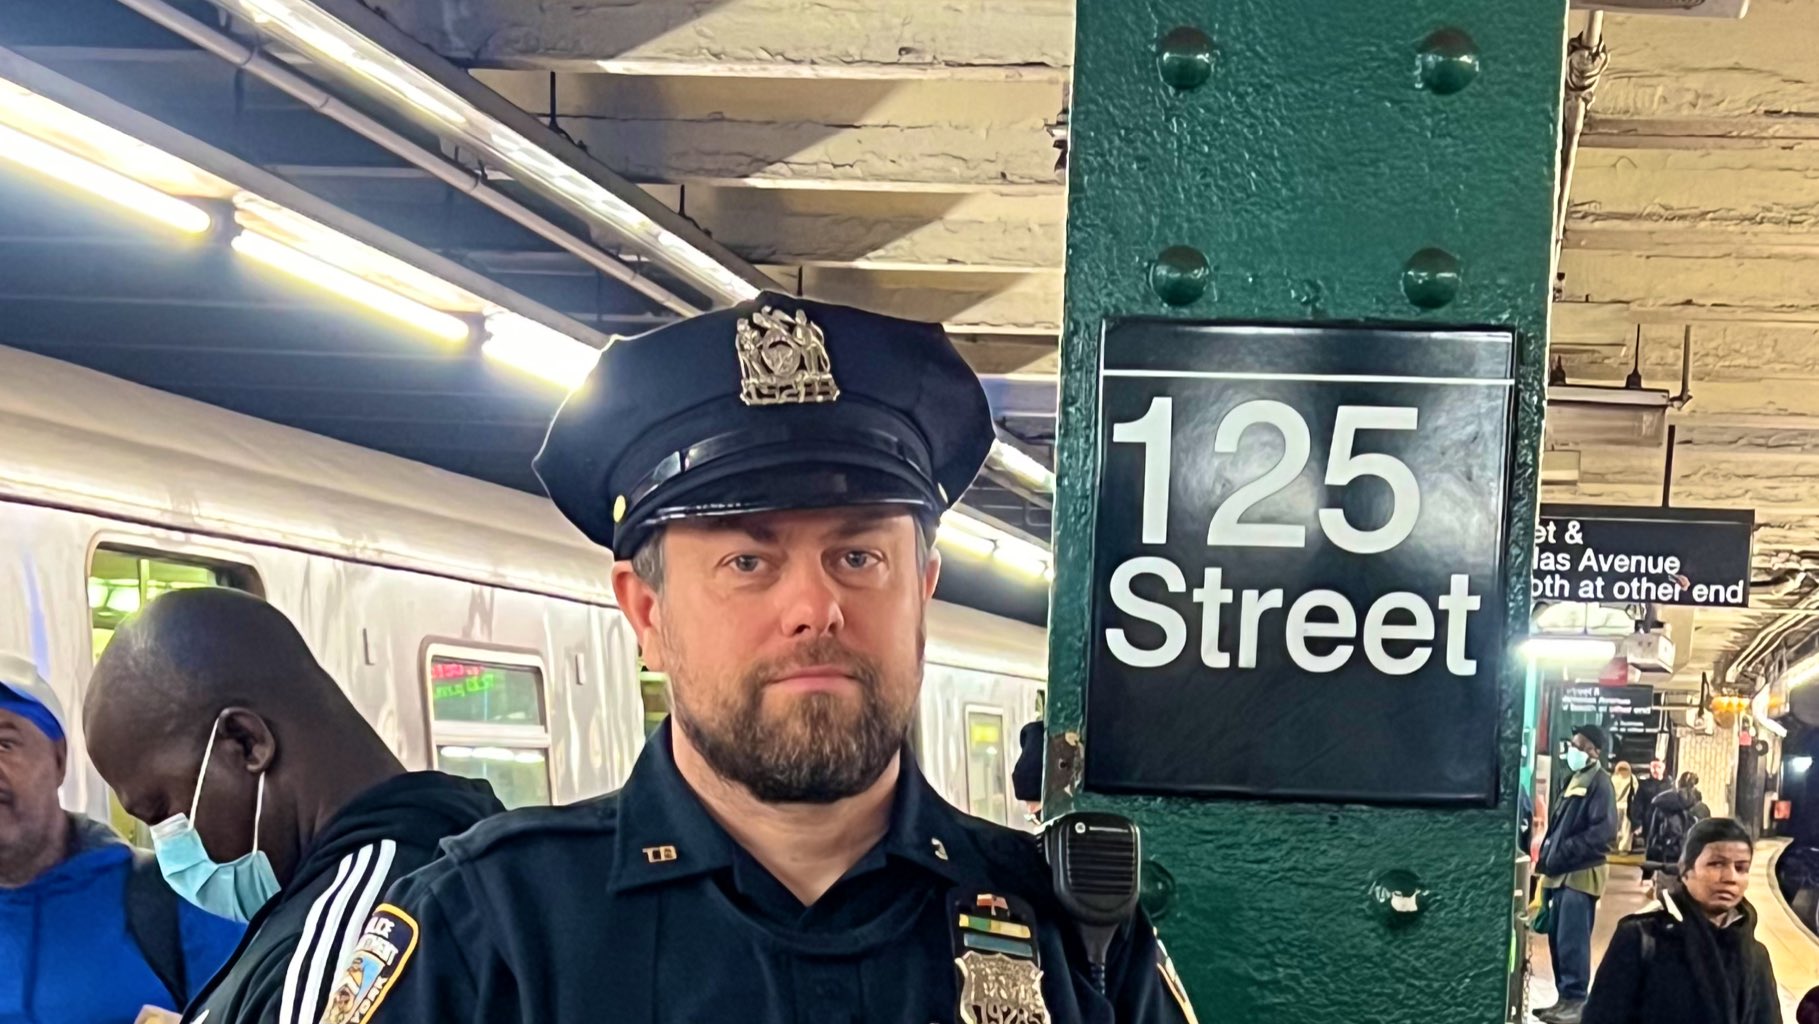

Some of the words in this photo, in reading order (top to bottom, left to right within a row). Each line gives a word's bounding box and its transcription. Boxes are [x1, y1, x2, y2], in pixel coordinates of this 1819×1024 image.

[1112, 396, 1421, 554] 125
[1565, 521, 1583, 545] &
[1578, 548, 1681, 574] Avenue
[1578, 576, 1604, 599] at
[1613, 577, 1682, 601] other
[1692, 580, 1744, 603] end
[1105, 556, 1481, 676] Street
